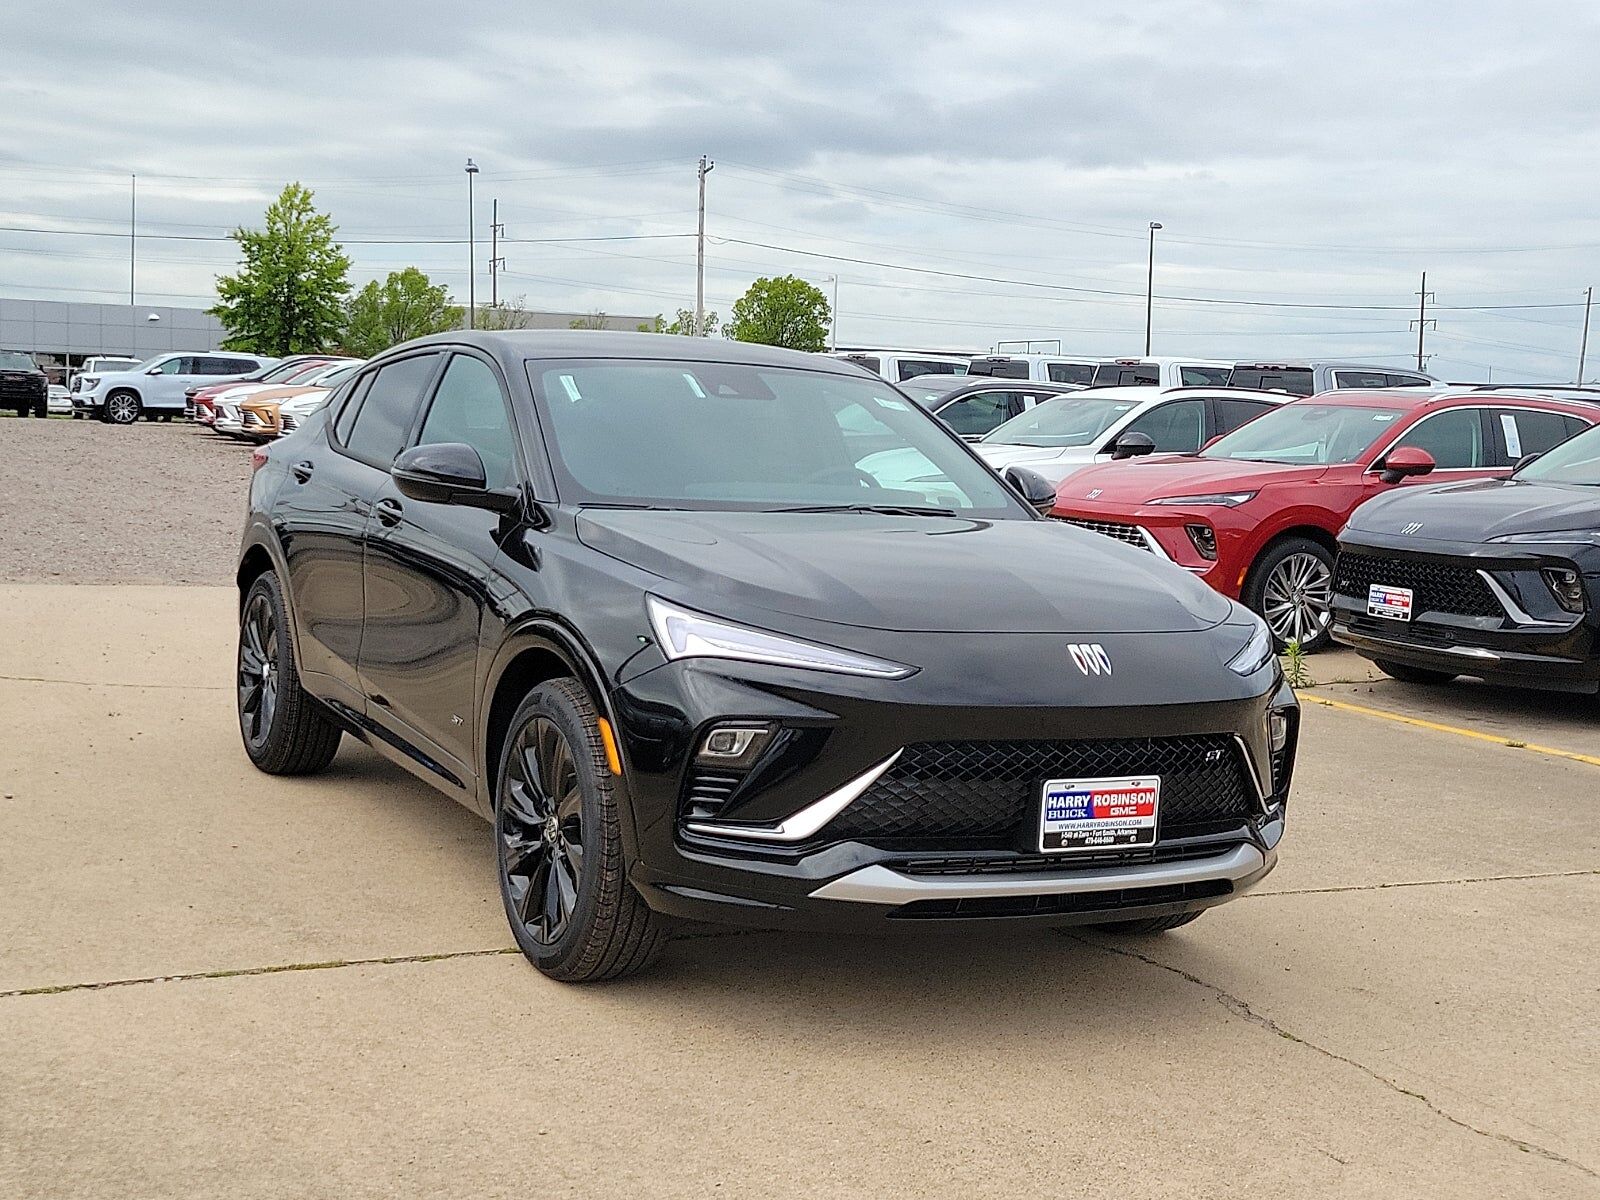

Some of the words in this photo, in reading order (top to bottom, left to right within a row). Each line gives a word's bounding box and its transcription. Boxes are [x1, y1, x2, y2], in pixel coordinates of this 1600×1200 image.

[1047, 795, 1091, 809] HARRY
[1094, 792, 1154, 807] ROBINSON
[1047, 808, 1088, 820] BUICK
[1110, 806, 1137, 816] GMC
[1058, 819, 1142, 830] WWW.HARRYROBINSON.COM
